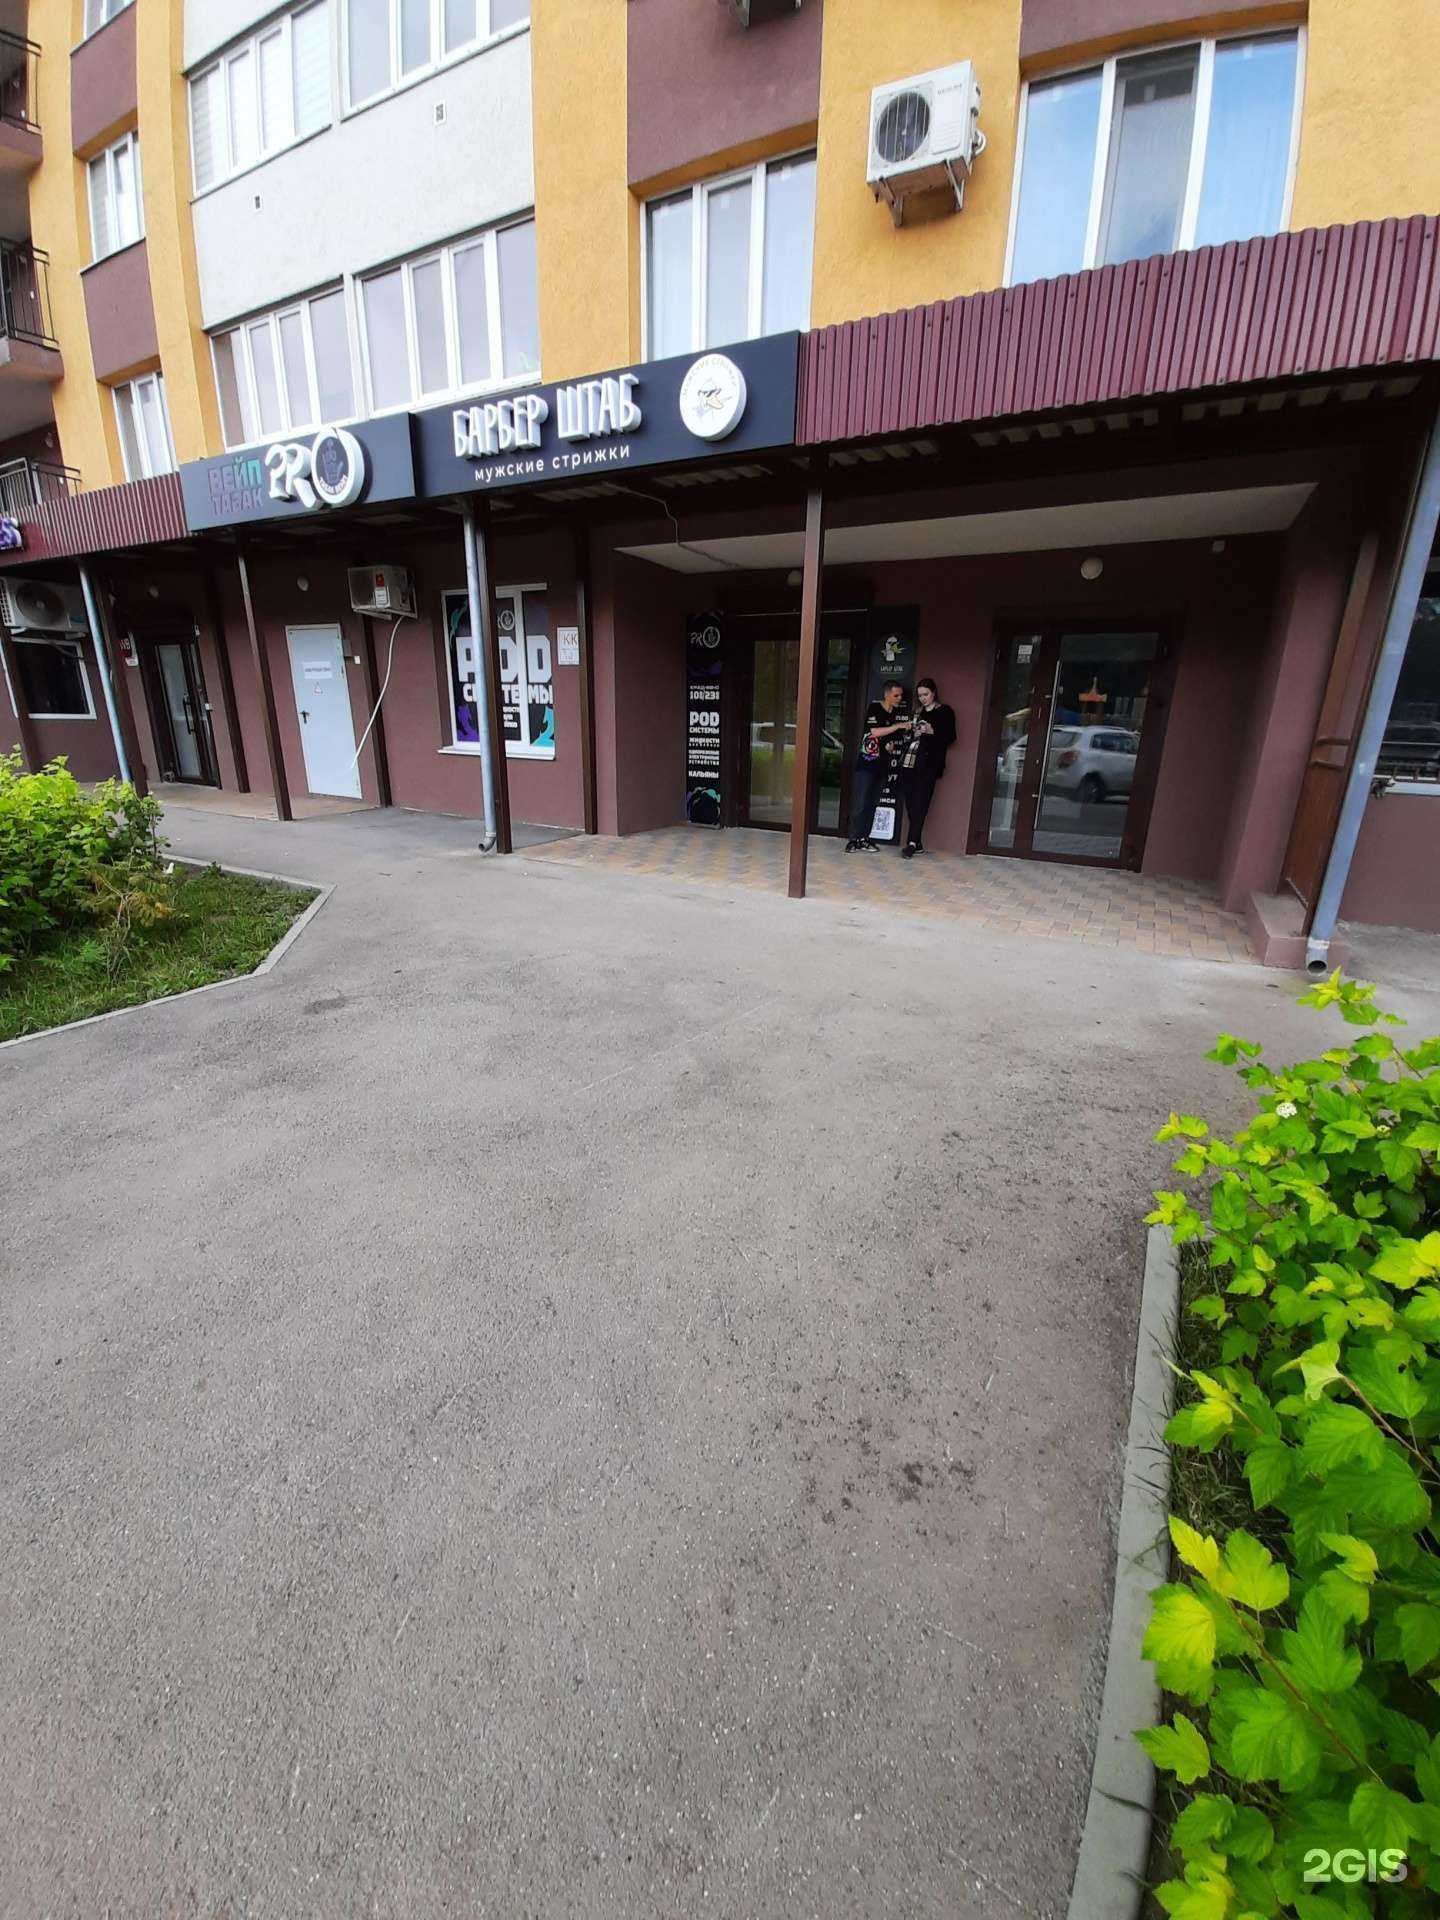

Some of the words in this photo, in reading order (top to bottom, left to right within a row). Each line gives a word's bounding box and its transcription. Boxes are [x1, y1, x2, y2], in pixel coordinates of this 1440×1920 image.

[453, 394, 549, 459] БАРБЕР
[556, 372, 642, 442] ШТАБ
[208, 456, 263, 496] ВЕЙП
[264, 427, 365, 509] PRO
[474, 457, 545, 482] мужские
[551, 444, 630, 471] стрижки
[462, 684, 552, 705] СТЕМЫ
[689, 711, 720, 727] POD
[689, 726, 720, 734] СИСТЕМЫ
[688, 770, 719, 779] КАЛЬЯНЫ
